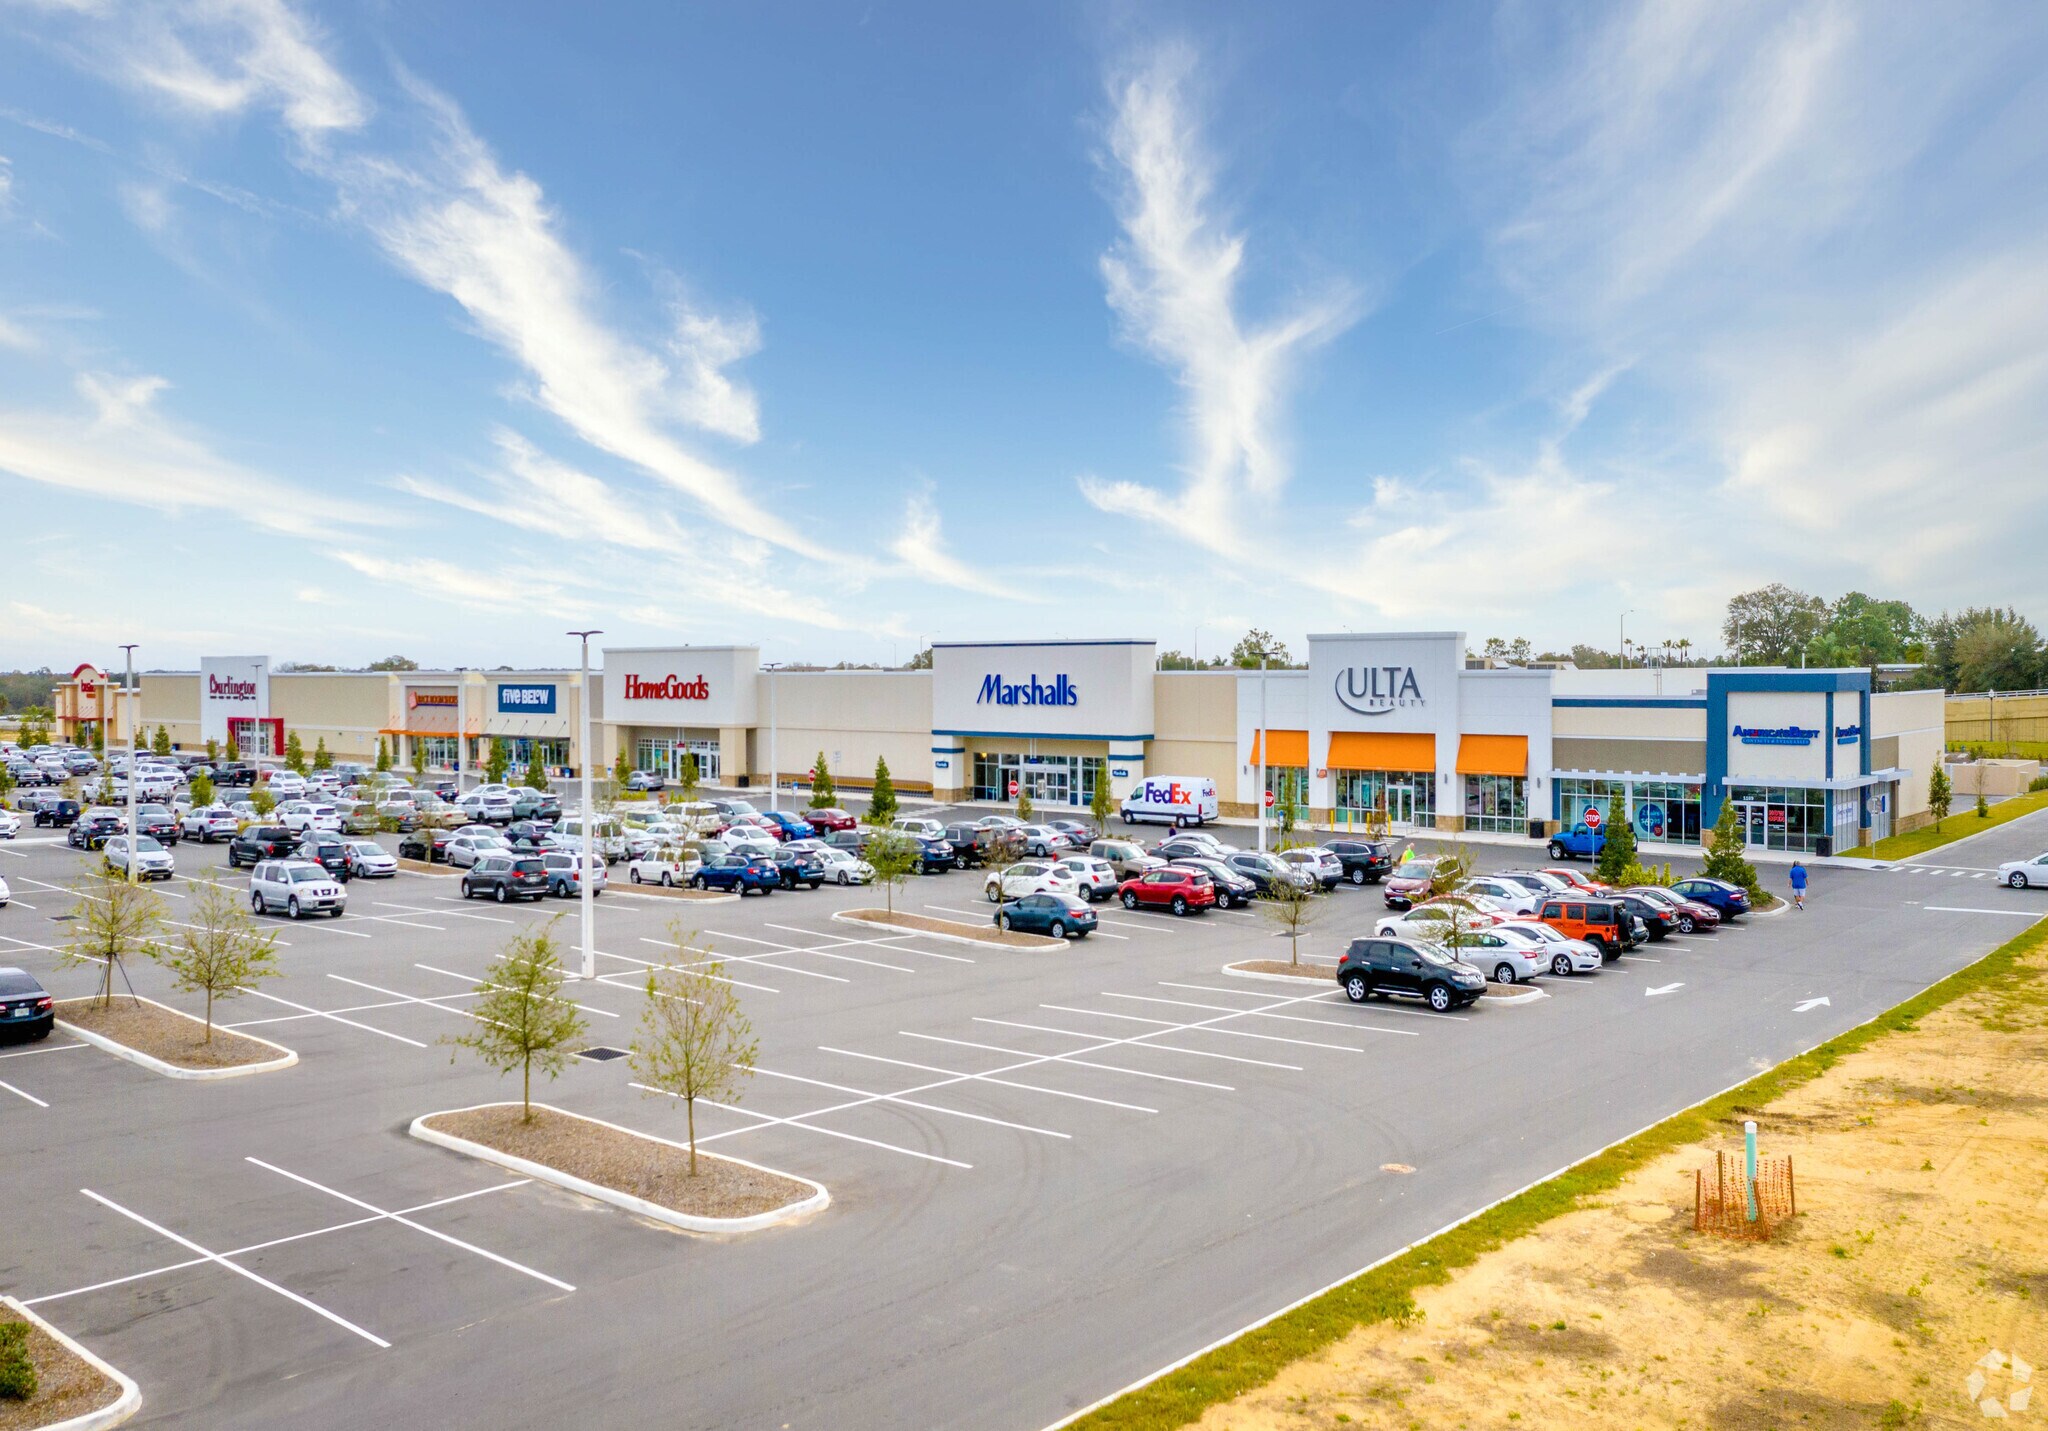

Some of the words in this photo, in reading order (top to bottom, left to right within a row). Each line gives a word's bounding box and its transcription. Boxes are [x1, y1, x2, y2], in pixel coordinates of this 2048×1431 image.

[209, 673, 256, 701] Burlington
[624, 674, 709, 699] HomeGoods
[977, 674, 1077, 705] Marshalls
[1347, 667, 1421, 698] ULTA
[1145, 782, 1191, 804] FedEx
[1202, 788, 1215, 797] FedEx
[1585, 814, 1599, 823] STOP
